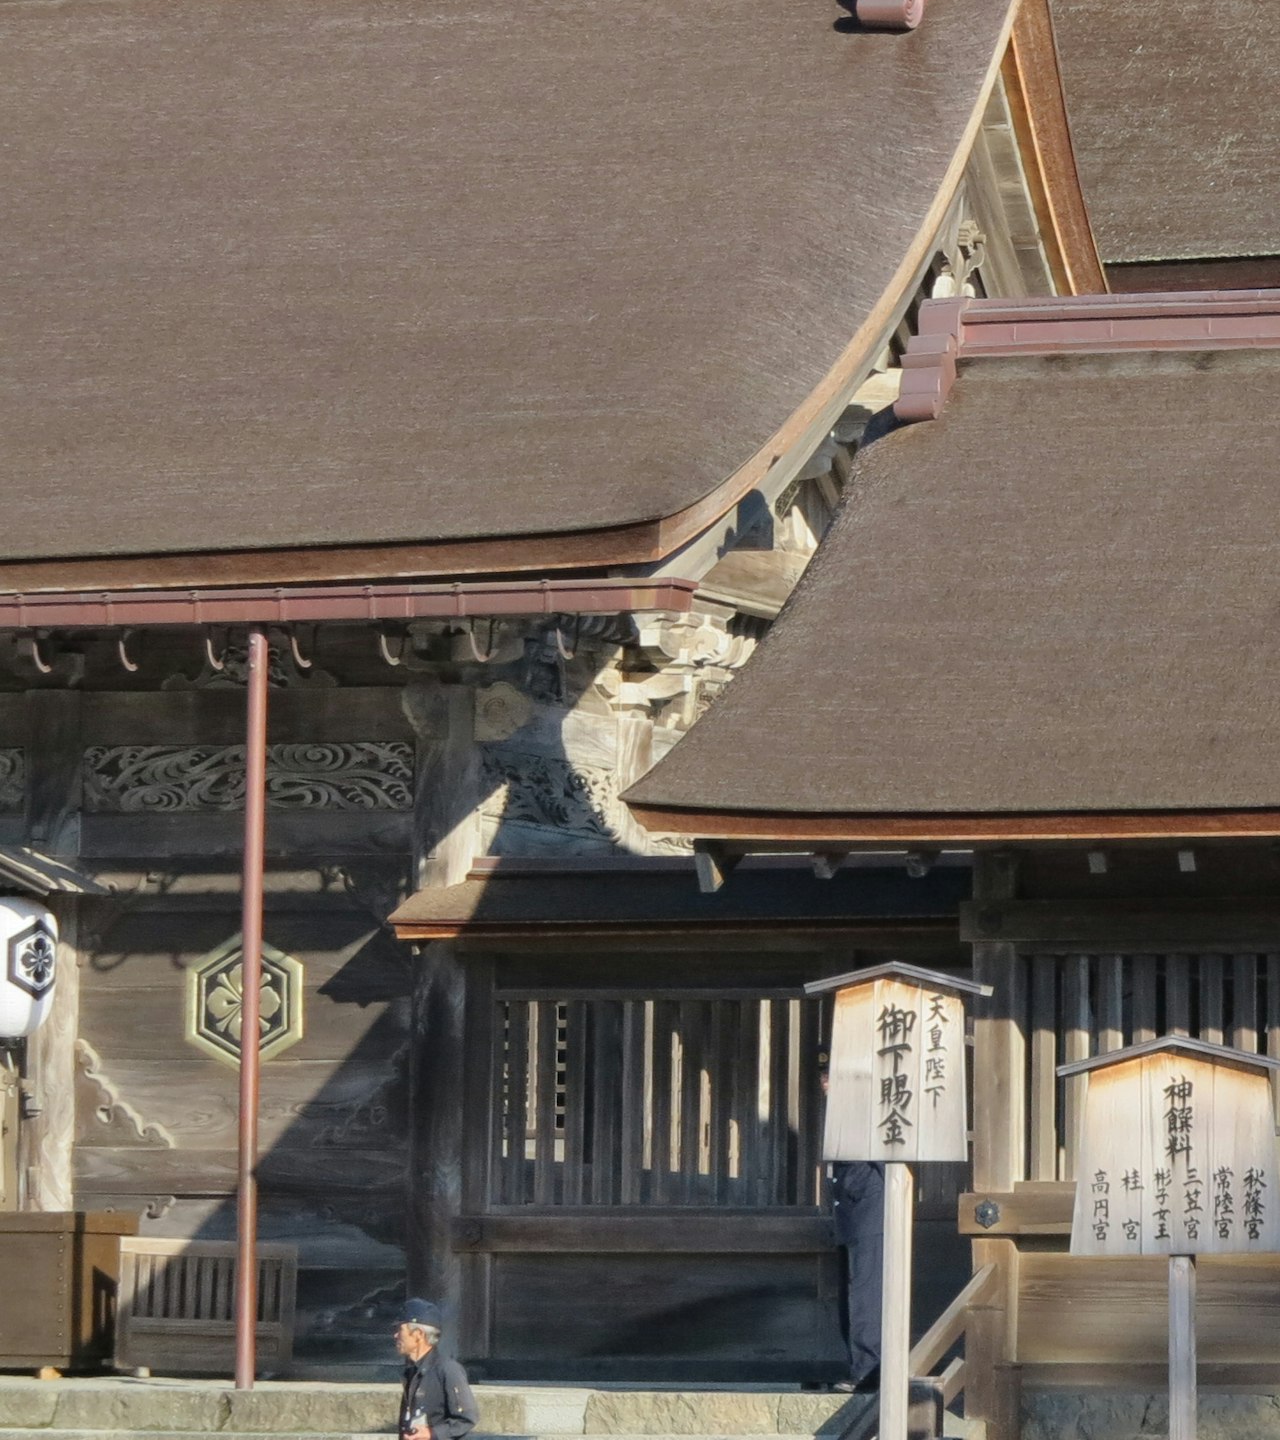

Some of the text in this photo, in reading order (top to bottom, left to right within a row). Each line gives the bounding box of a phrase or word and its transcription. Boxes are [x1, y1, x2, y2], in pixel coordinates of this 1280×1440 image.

[876, 1003, 918, 1145] 御下賜金
[924, 994, 950, 1109] 天皇陛下
[1163, 1075, 1193, 1165] 神饌料
[1091, 1168, 1110, 1241] 高円宮
[1152, 1167, 1172, 1240] 彬子女王
[1183, 1168, 1204, 1240] 三笠宮
[1213, 1166, 1234, 1239] 常陸宮
[1242, 1166, 1267, 1240] 秋篠宮
